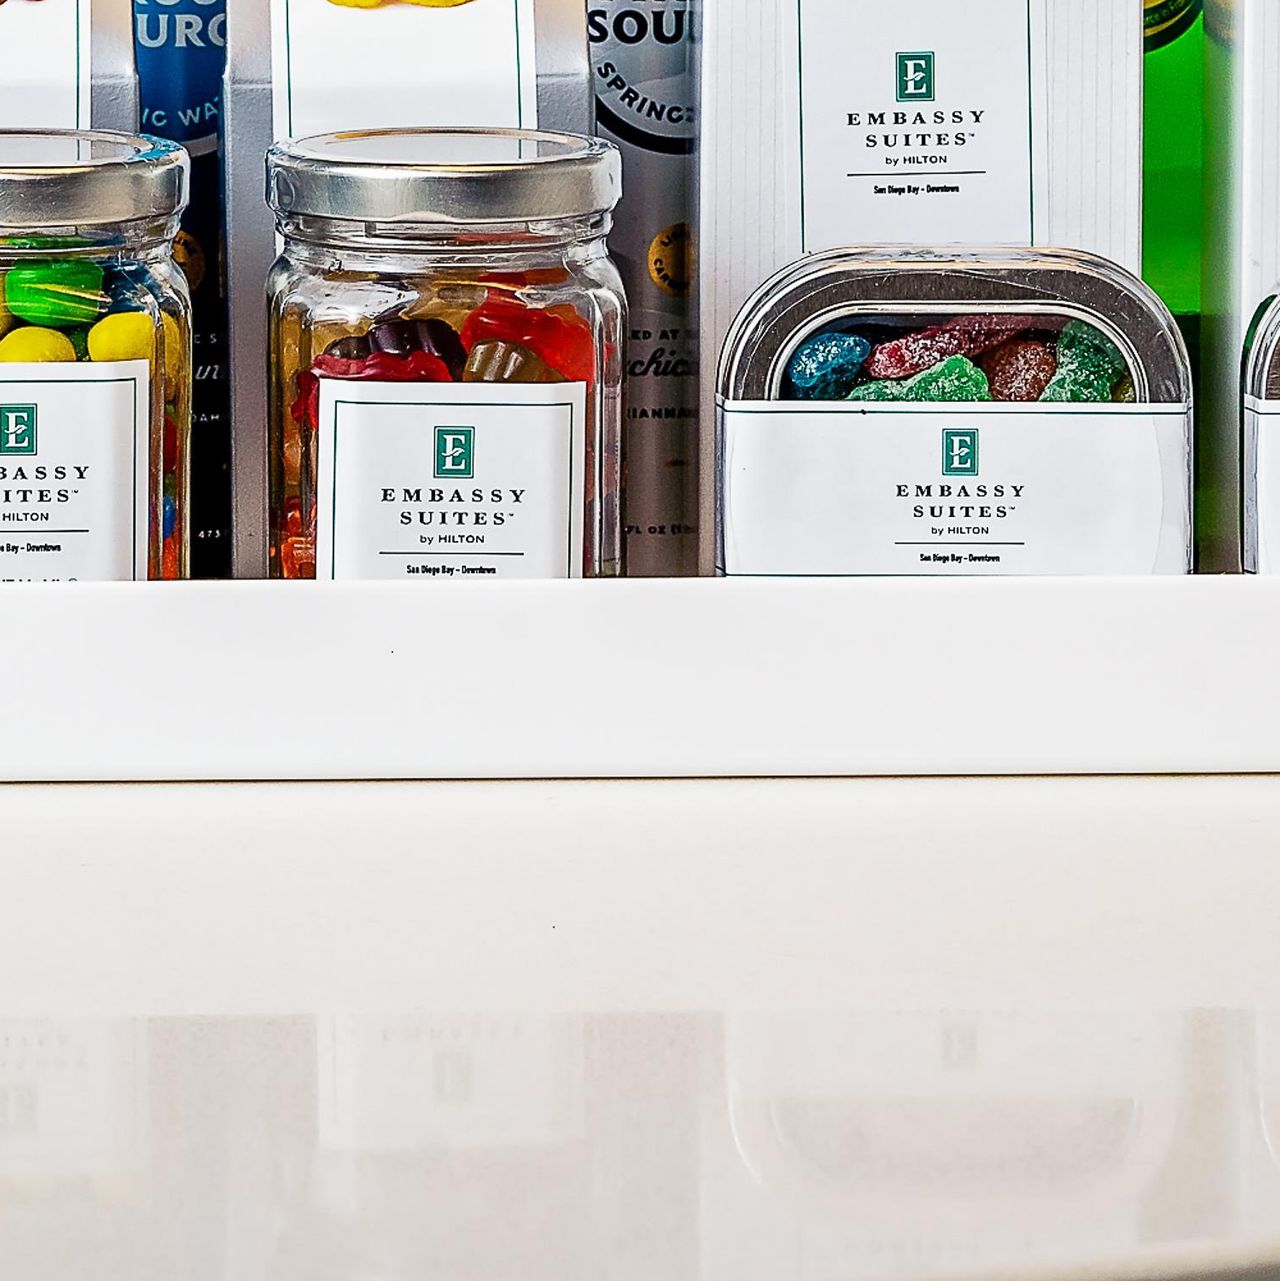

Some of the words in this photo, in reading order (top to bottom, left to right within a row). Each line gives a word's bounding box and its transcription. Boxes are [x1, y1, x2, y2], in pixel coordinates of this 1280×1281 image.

[847, 110, 985, 126] EMBASSY
[885, 157, 899, 167] by
[903, 155, 948, 165] HILTON
[381, 488, 525, 503] EMBASSY
[896, 484, 1025, 498] EMBASSY
[2, 512, 50, 521] HILTON
[931, 526, 944, 536] by
[947, 526, 990, 535] HILTON
[420, 535, 434, 545] by
[438, 534, 485, 544] HILTON
